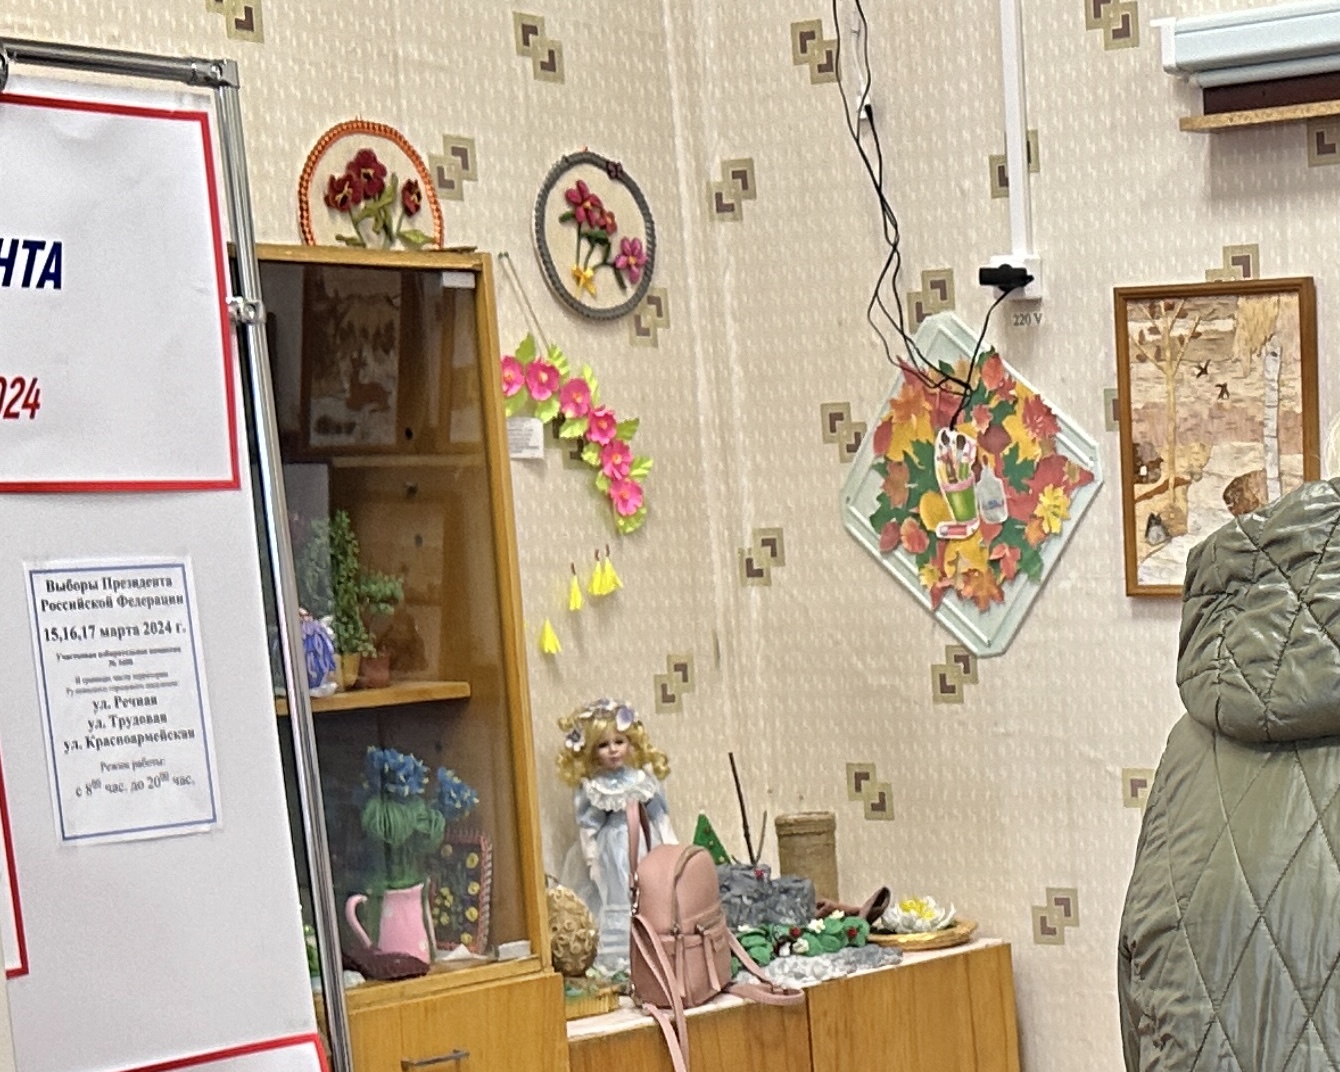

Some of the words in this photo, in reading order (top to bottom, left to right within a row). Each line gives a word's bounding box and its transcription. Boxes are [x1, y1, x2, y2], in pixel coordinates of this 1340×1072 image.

[1012, 312, 1032, 326] 220
[1033, 312, 1043, 325] V
[46, 579, 98, 594] Выборы
[102, 575, 173, 593] Президента
[40, 596, 114, 612] Российской
[116, 593, 184, 610] Федерации
[44, 624, 96, 643] 15,16,17
[100, 625, 140, 641] марта
[143, 620, 172, 635] 2024
[93, 700, 112, 714] ул.
[113, 695, 158, 710] Речная
[87, 718, 106, 733] ул.
[108, 713, 168, 730] Трудовая
[63, 740, 83, 755] ул.
[85, 727, 195, 751] Красноармейская
